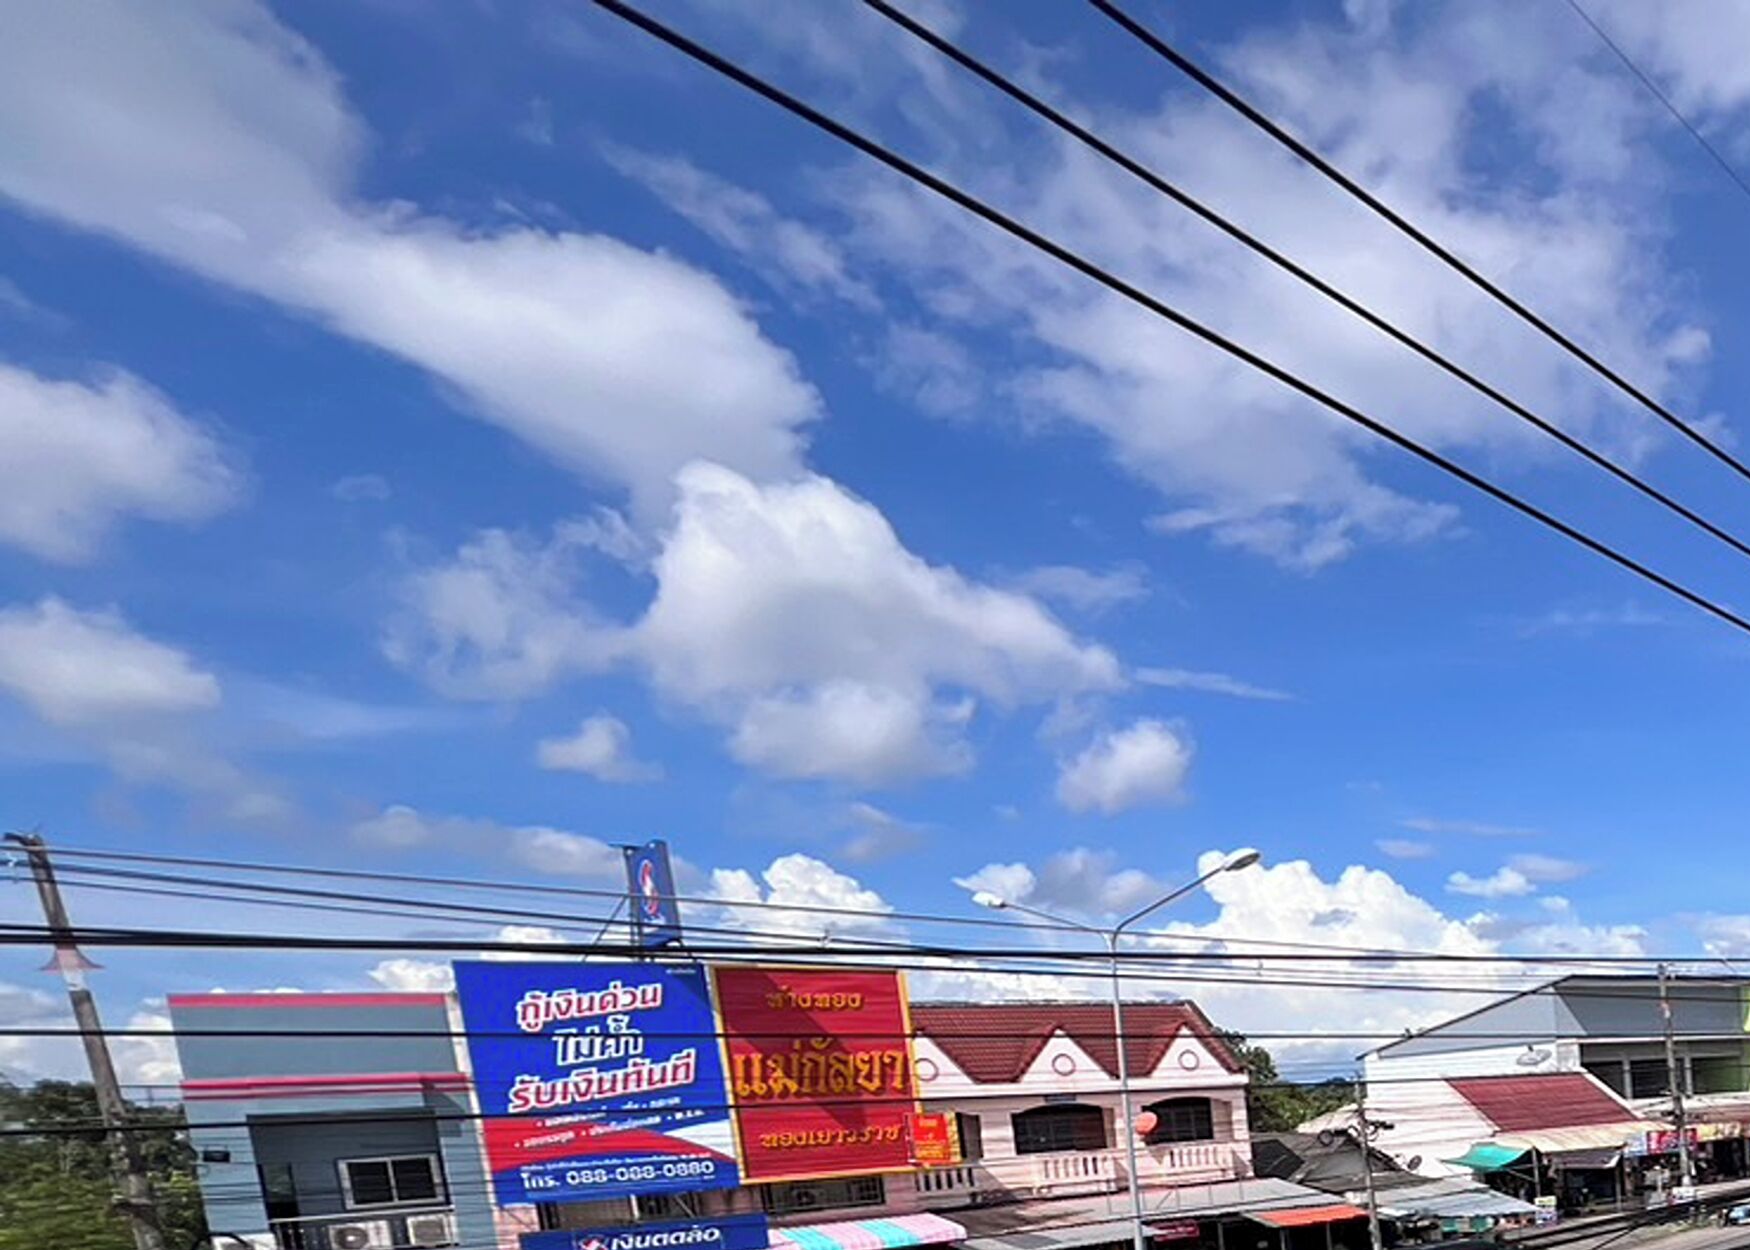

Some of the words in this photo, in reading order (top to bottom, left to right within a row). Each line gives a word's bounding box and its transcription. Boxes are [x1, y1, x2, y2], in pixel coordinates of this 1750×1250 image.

[516, 980, 663, 1032] กู้เงินด่วน
[508, 1048, 697, 1113] รับเงินทันที
[733, 1037, 906, 1097] แม่กัลยา
